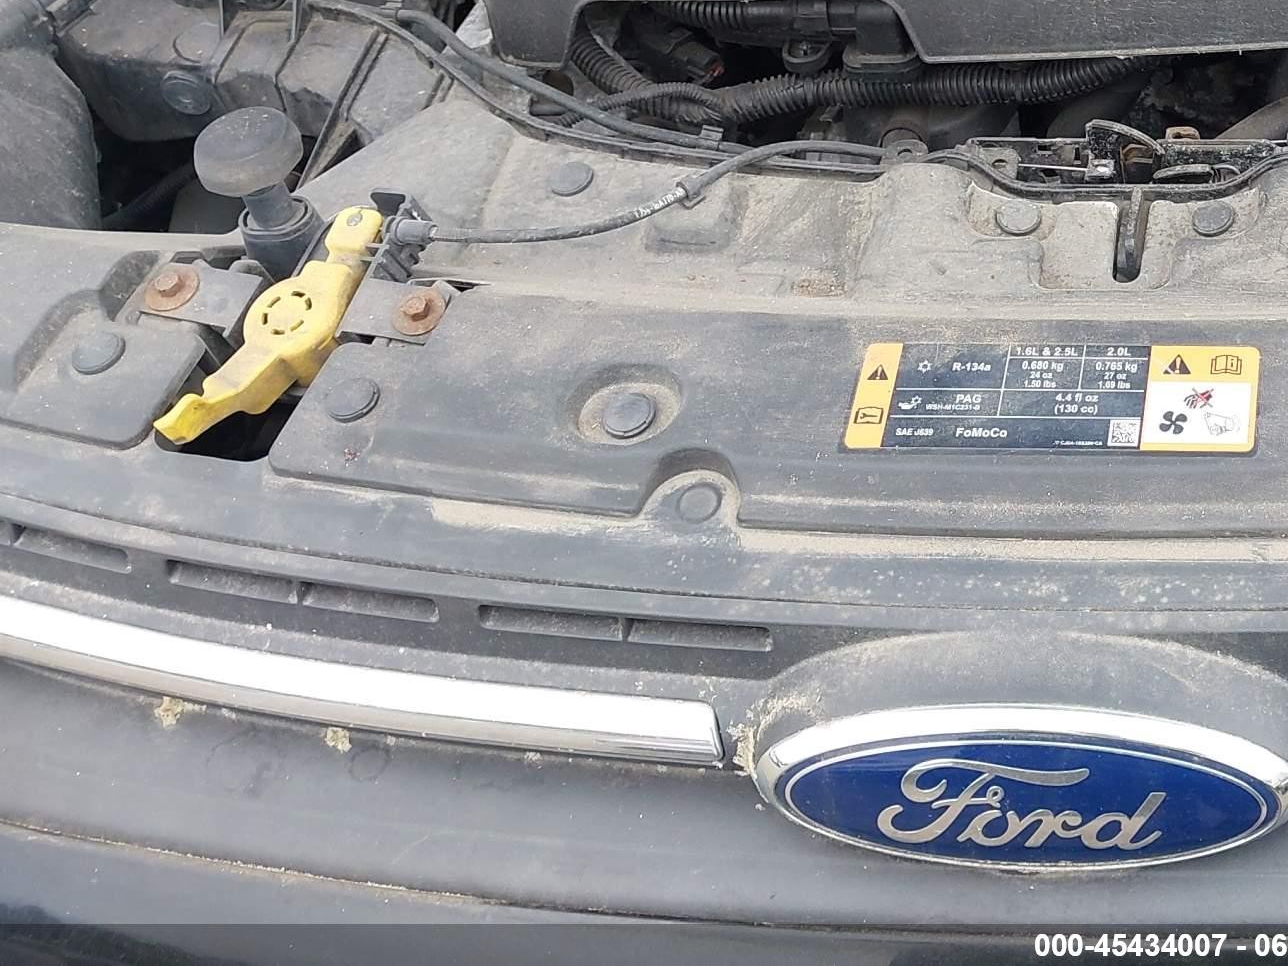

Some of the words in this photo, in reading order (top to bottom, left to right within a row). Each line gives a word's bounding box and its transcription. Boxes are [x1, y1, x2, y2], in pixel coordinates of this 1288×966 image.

[1016, 346, 1040, 356] 1.6L
[1042, 347, 1051, 356] &
[1053, 347, 1079, 356] 2.5L
[1107, 347, 1132, 356] 2.0L
[952, 362, 992, 372] R-134a
[1051, 361, 1064, 372] kg
[1124, 361, 1138, 373] kg
[1104, 372, 1115, 380] 27
[1023, 380, 1041, 388] 1.50
[1043, 380, 1057, 388] lbs
[1117, 381, 1131, 389] lbs
[955, 394, 982, 404] PAG
[1055, 393, 1073, 402] 4.4
[1075, 393, 1083, 403] fl
[1085, 394, 1099, 402] oz
[1054, 404, 1078, 415] (130
[896, 428, 914, 436] SAE
[955, 427, 1008, 438] FoMoCo
[876, 757, 1167, 850] Ford
